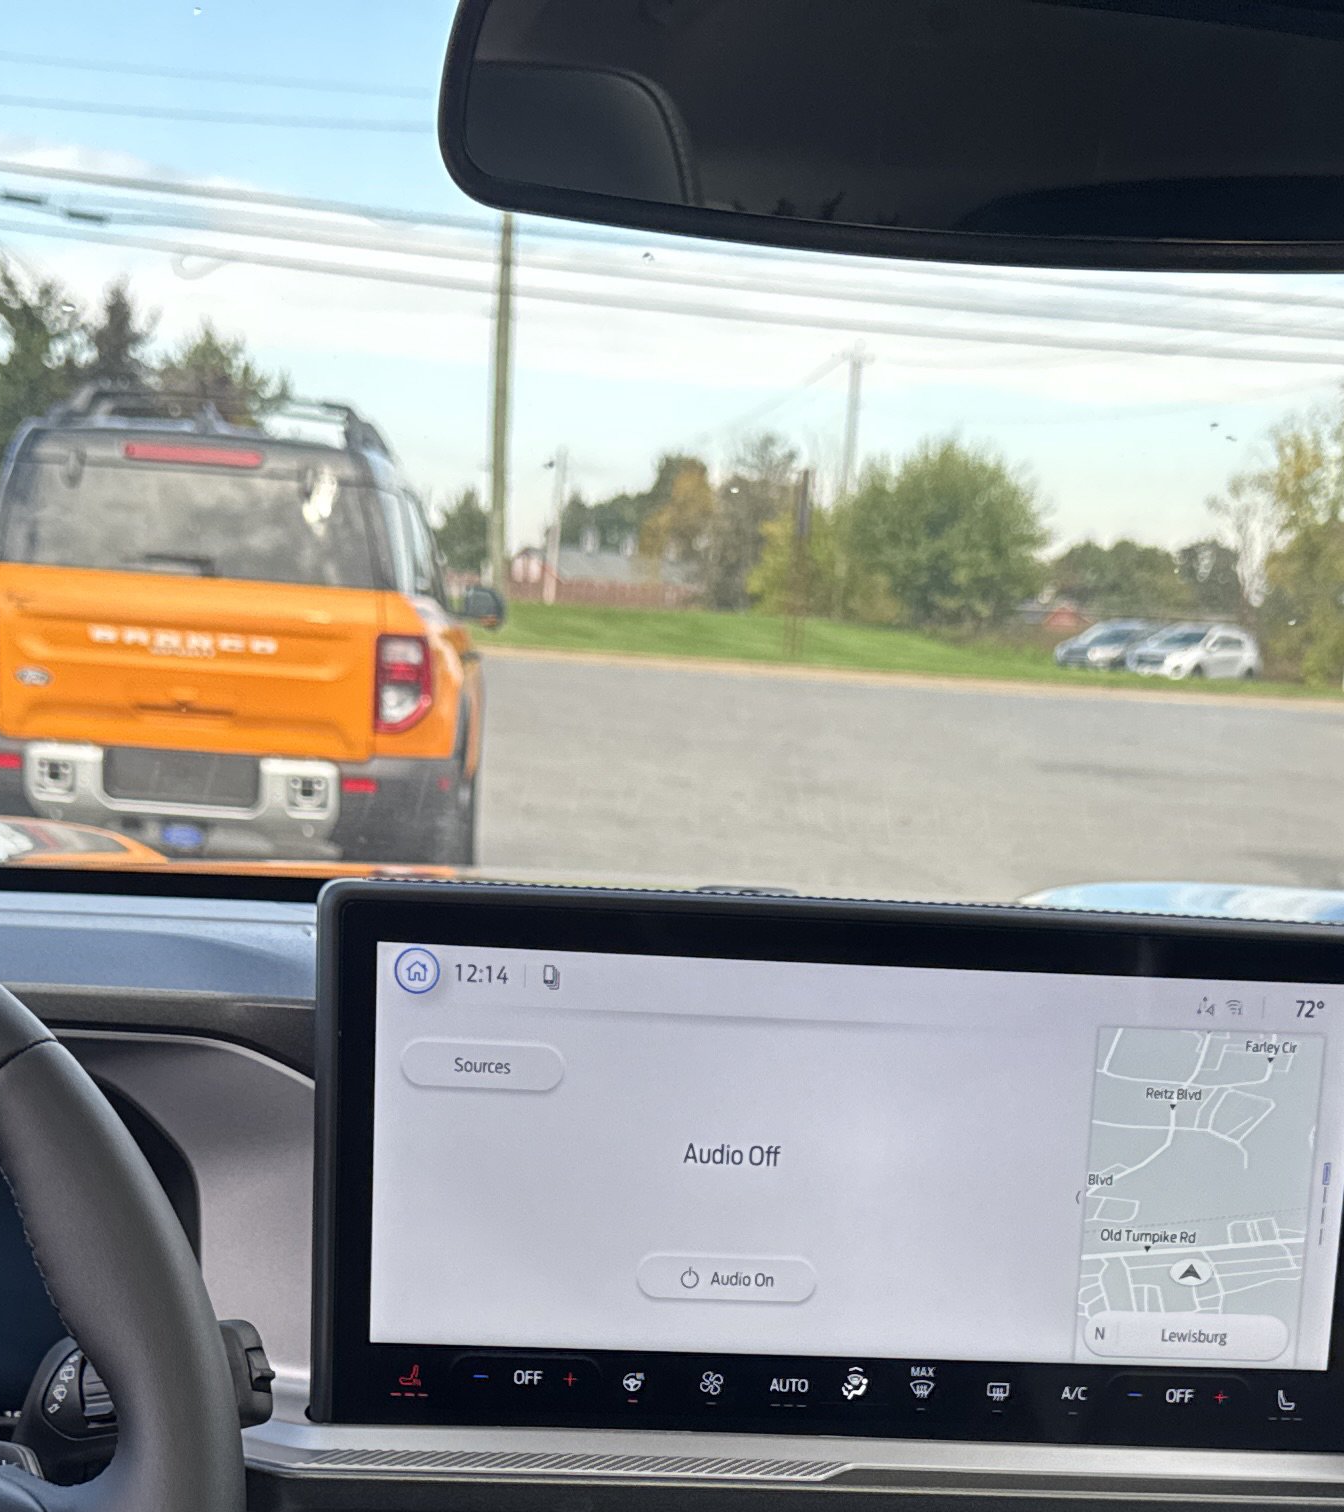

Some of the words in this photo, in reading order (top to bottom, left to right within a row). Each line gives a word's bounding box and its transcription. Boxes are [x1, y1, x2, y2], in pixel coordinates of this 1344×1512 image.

[455, 963, 509, 985] 12:14
[1295, 1000, 1325, 1018] 72°
[1245, 1040, 1280, 1054] Farley
[1282, 1041, 1297, 1053] Cir
[454, 1056, 511, 1075] Sources
[1146, 1087, 1174, 1100] Reitz
[1177, 1088, 1202, 1101] Blvd
[683, 1142, 744, 1166] Audio
[749, 1145, 782, 1167] Off
[1088, 1173, 1113, 1186] Blvd
[1100, 1228, 1122, 1242] Old
[1126, 1229, 1177, 1244] Turnpike
[1180, 1231, 1197, 1244] Rd
[711, 1271, 751, 1287] Audio
[754, 1272, 775, 1288] On
[1094, 1326, 1106, 1341] N
[1161, 1328, 1227, 1347] Lewisburg
[513, 1369, 543, 1386] OFF
[910, 1365, 936, 1378] MAX
[769, 1378, 810, 1394] AUTO
[1060, 1385, 1088, 1401] A/C
[1165, 1388, 1195, 1404] OFF
